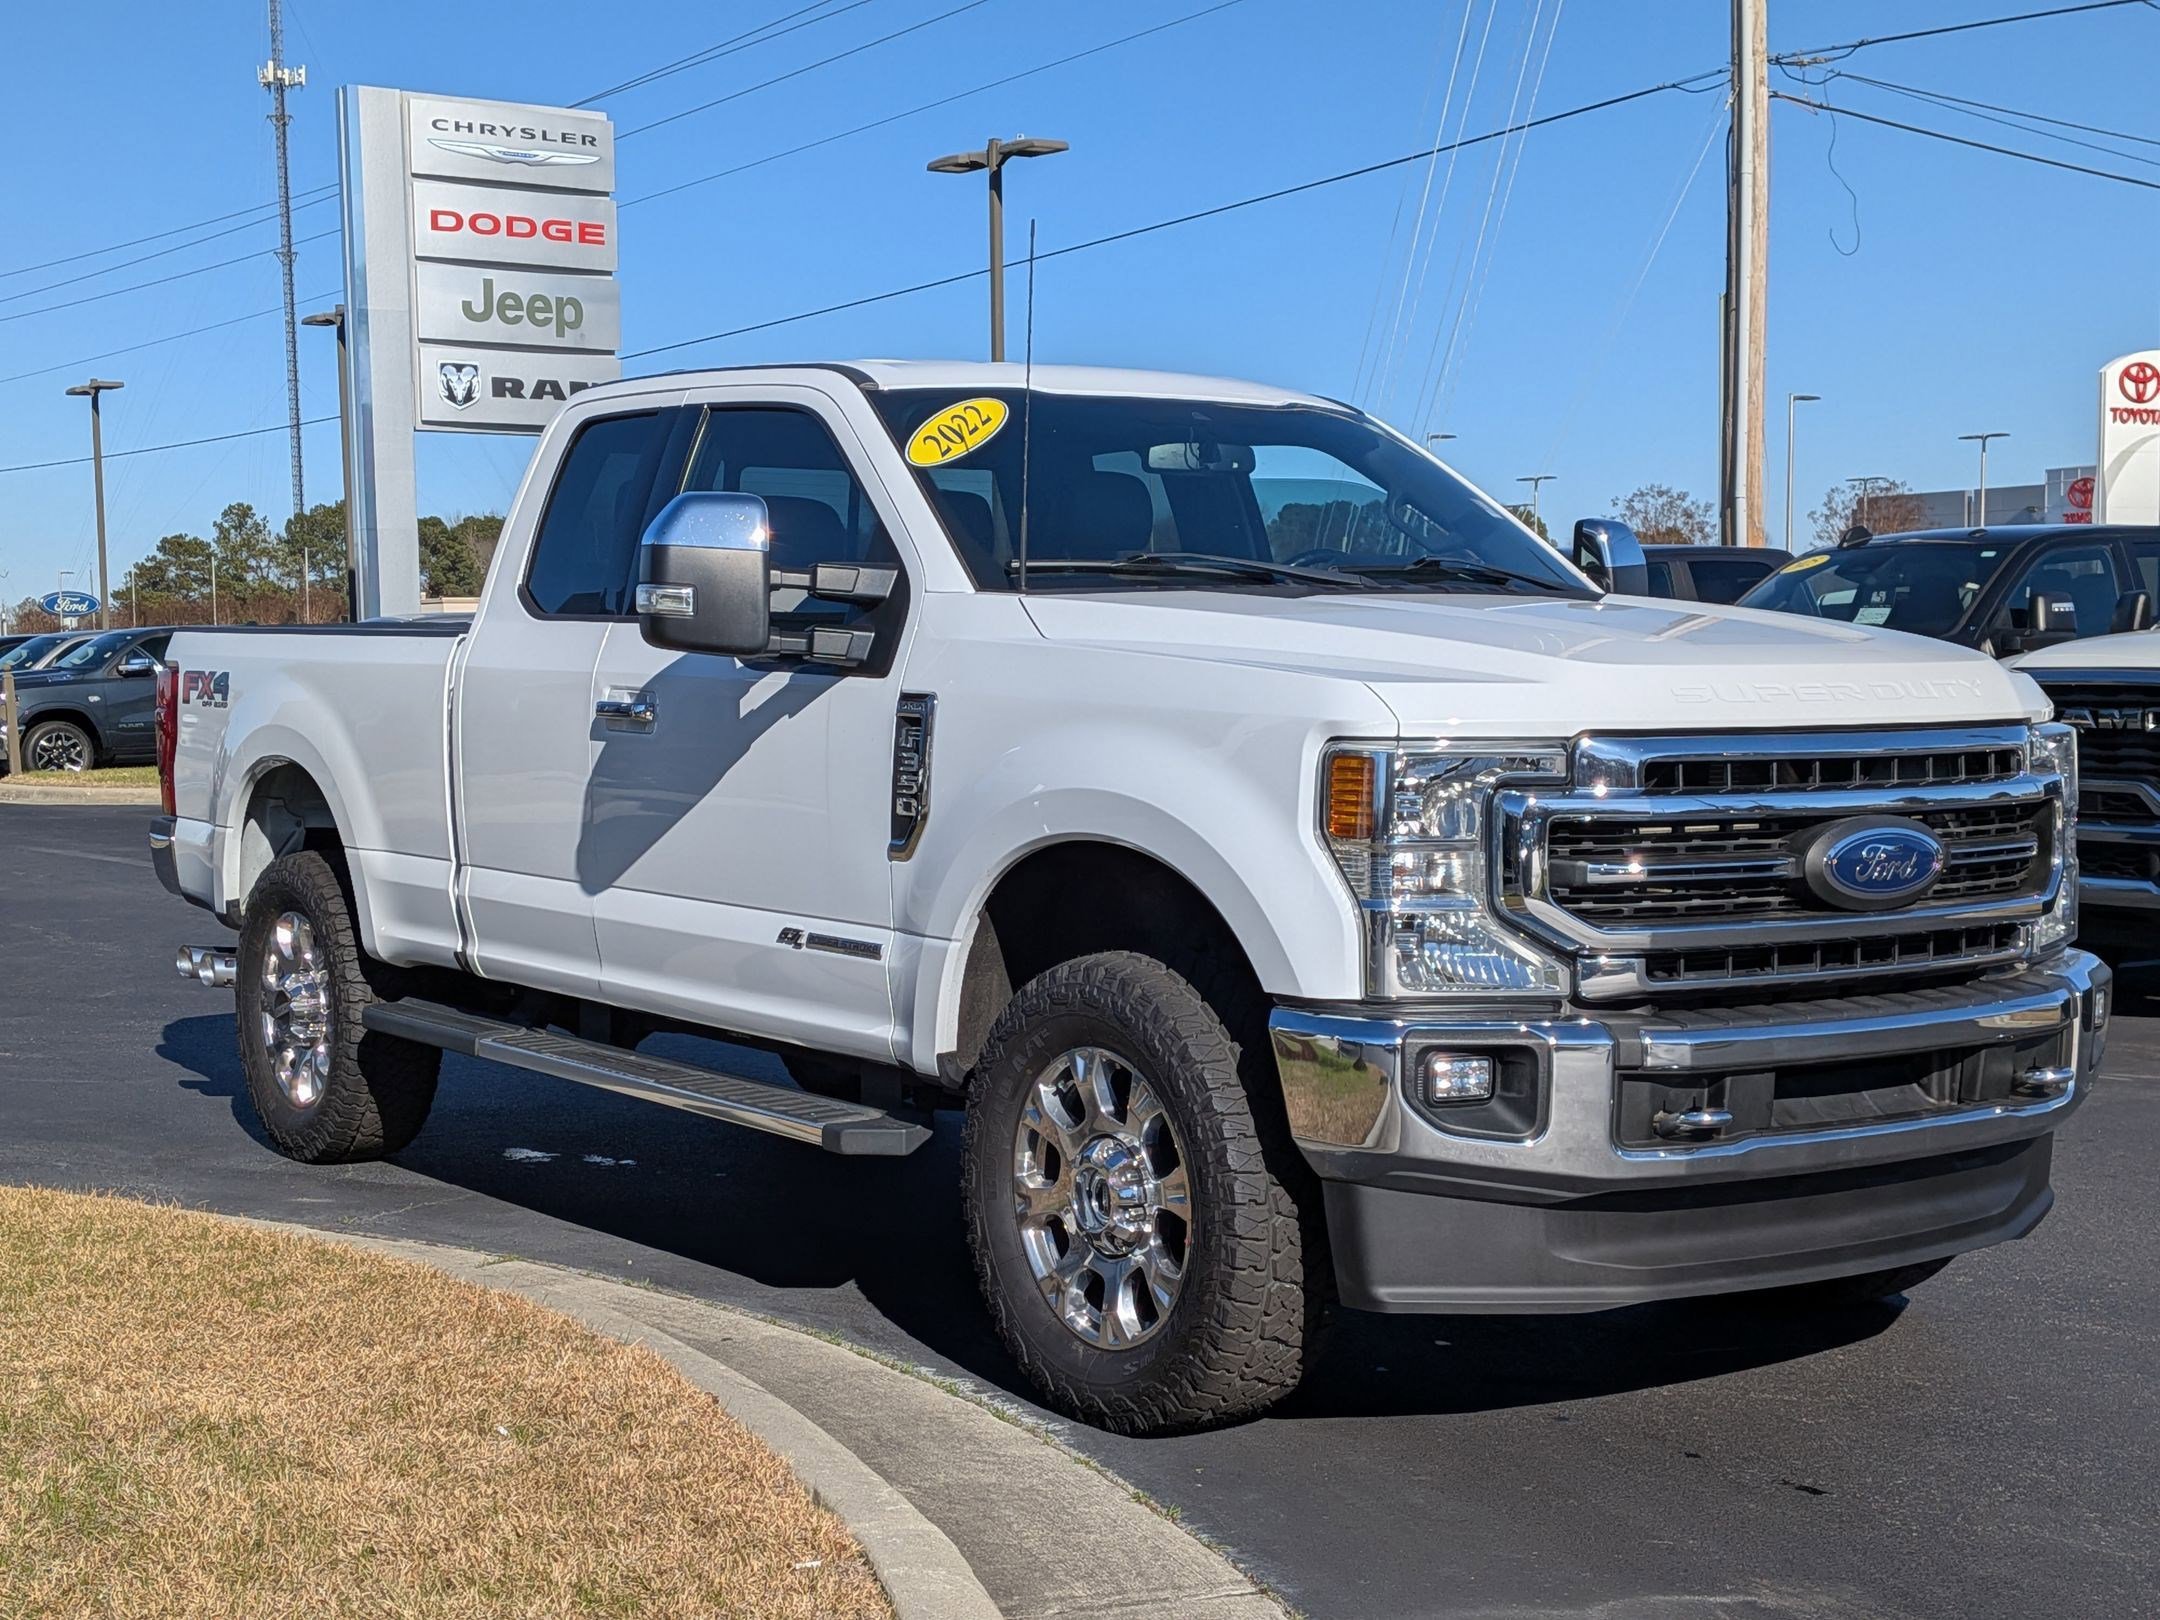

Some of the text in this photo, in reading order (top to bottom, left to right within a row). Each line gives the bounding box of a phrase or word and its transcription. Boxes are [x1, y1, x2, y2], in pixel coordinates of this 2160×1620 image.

[431, 118, 598, 147] CHRYSLER
[430, 209, 606, 245] DODGE
[461, 278, 584, 338] Jeep
[923, 405, 992, 458] 2022
[54, 596, 89, 612] Ford
[182, 670, 230, 705] FX4
[1669, 679, 1983, 704] SUPER DUTY
[1855, 843, 1918, 883] Ford
